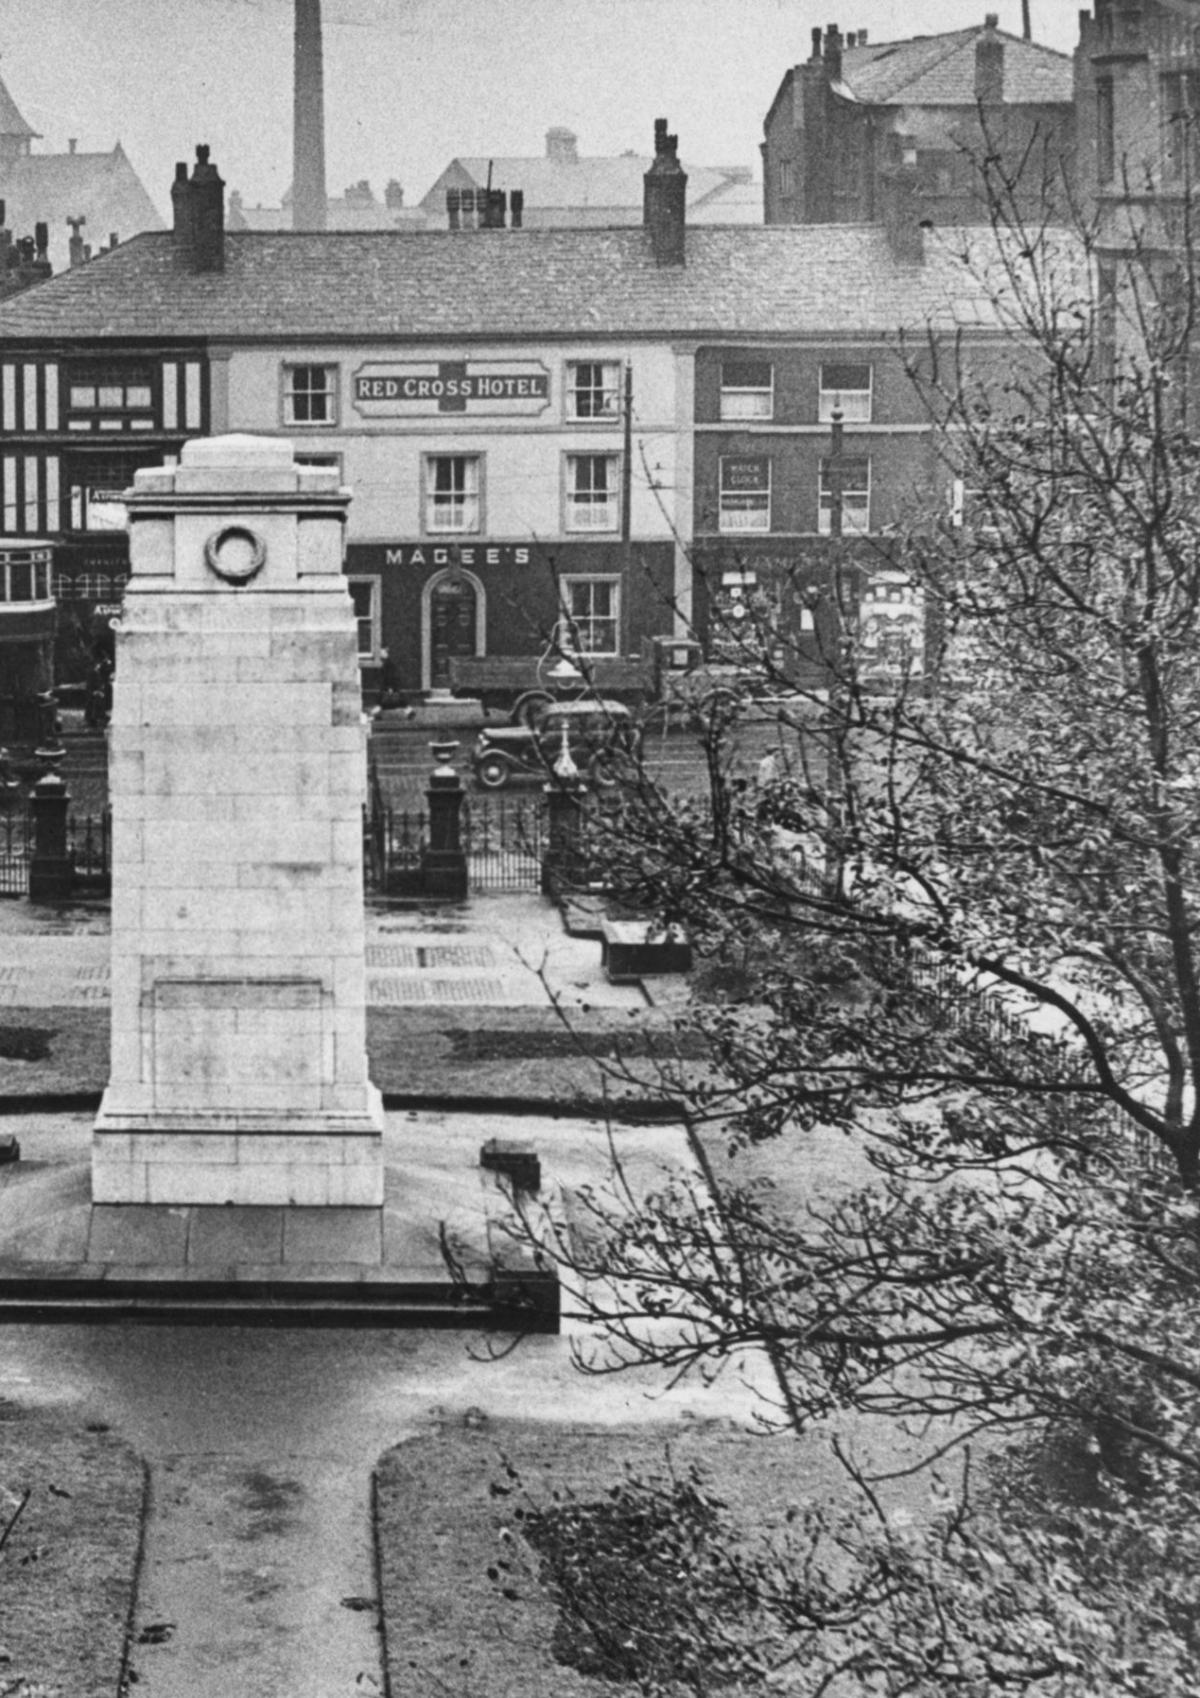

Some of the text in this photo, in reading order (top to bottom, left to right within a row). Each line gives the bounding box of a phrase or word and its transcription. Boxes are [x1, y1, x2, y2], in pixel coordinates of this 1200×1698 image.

[359, 377, 542, 397] RED CROSS HOTEL
[386, 547, 529, 565] MAGEE'S
